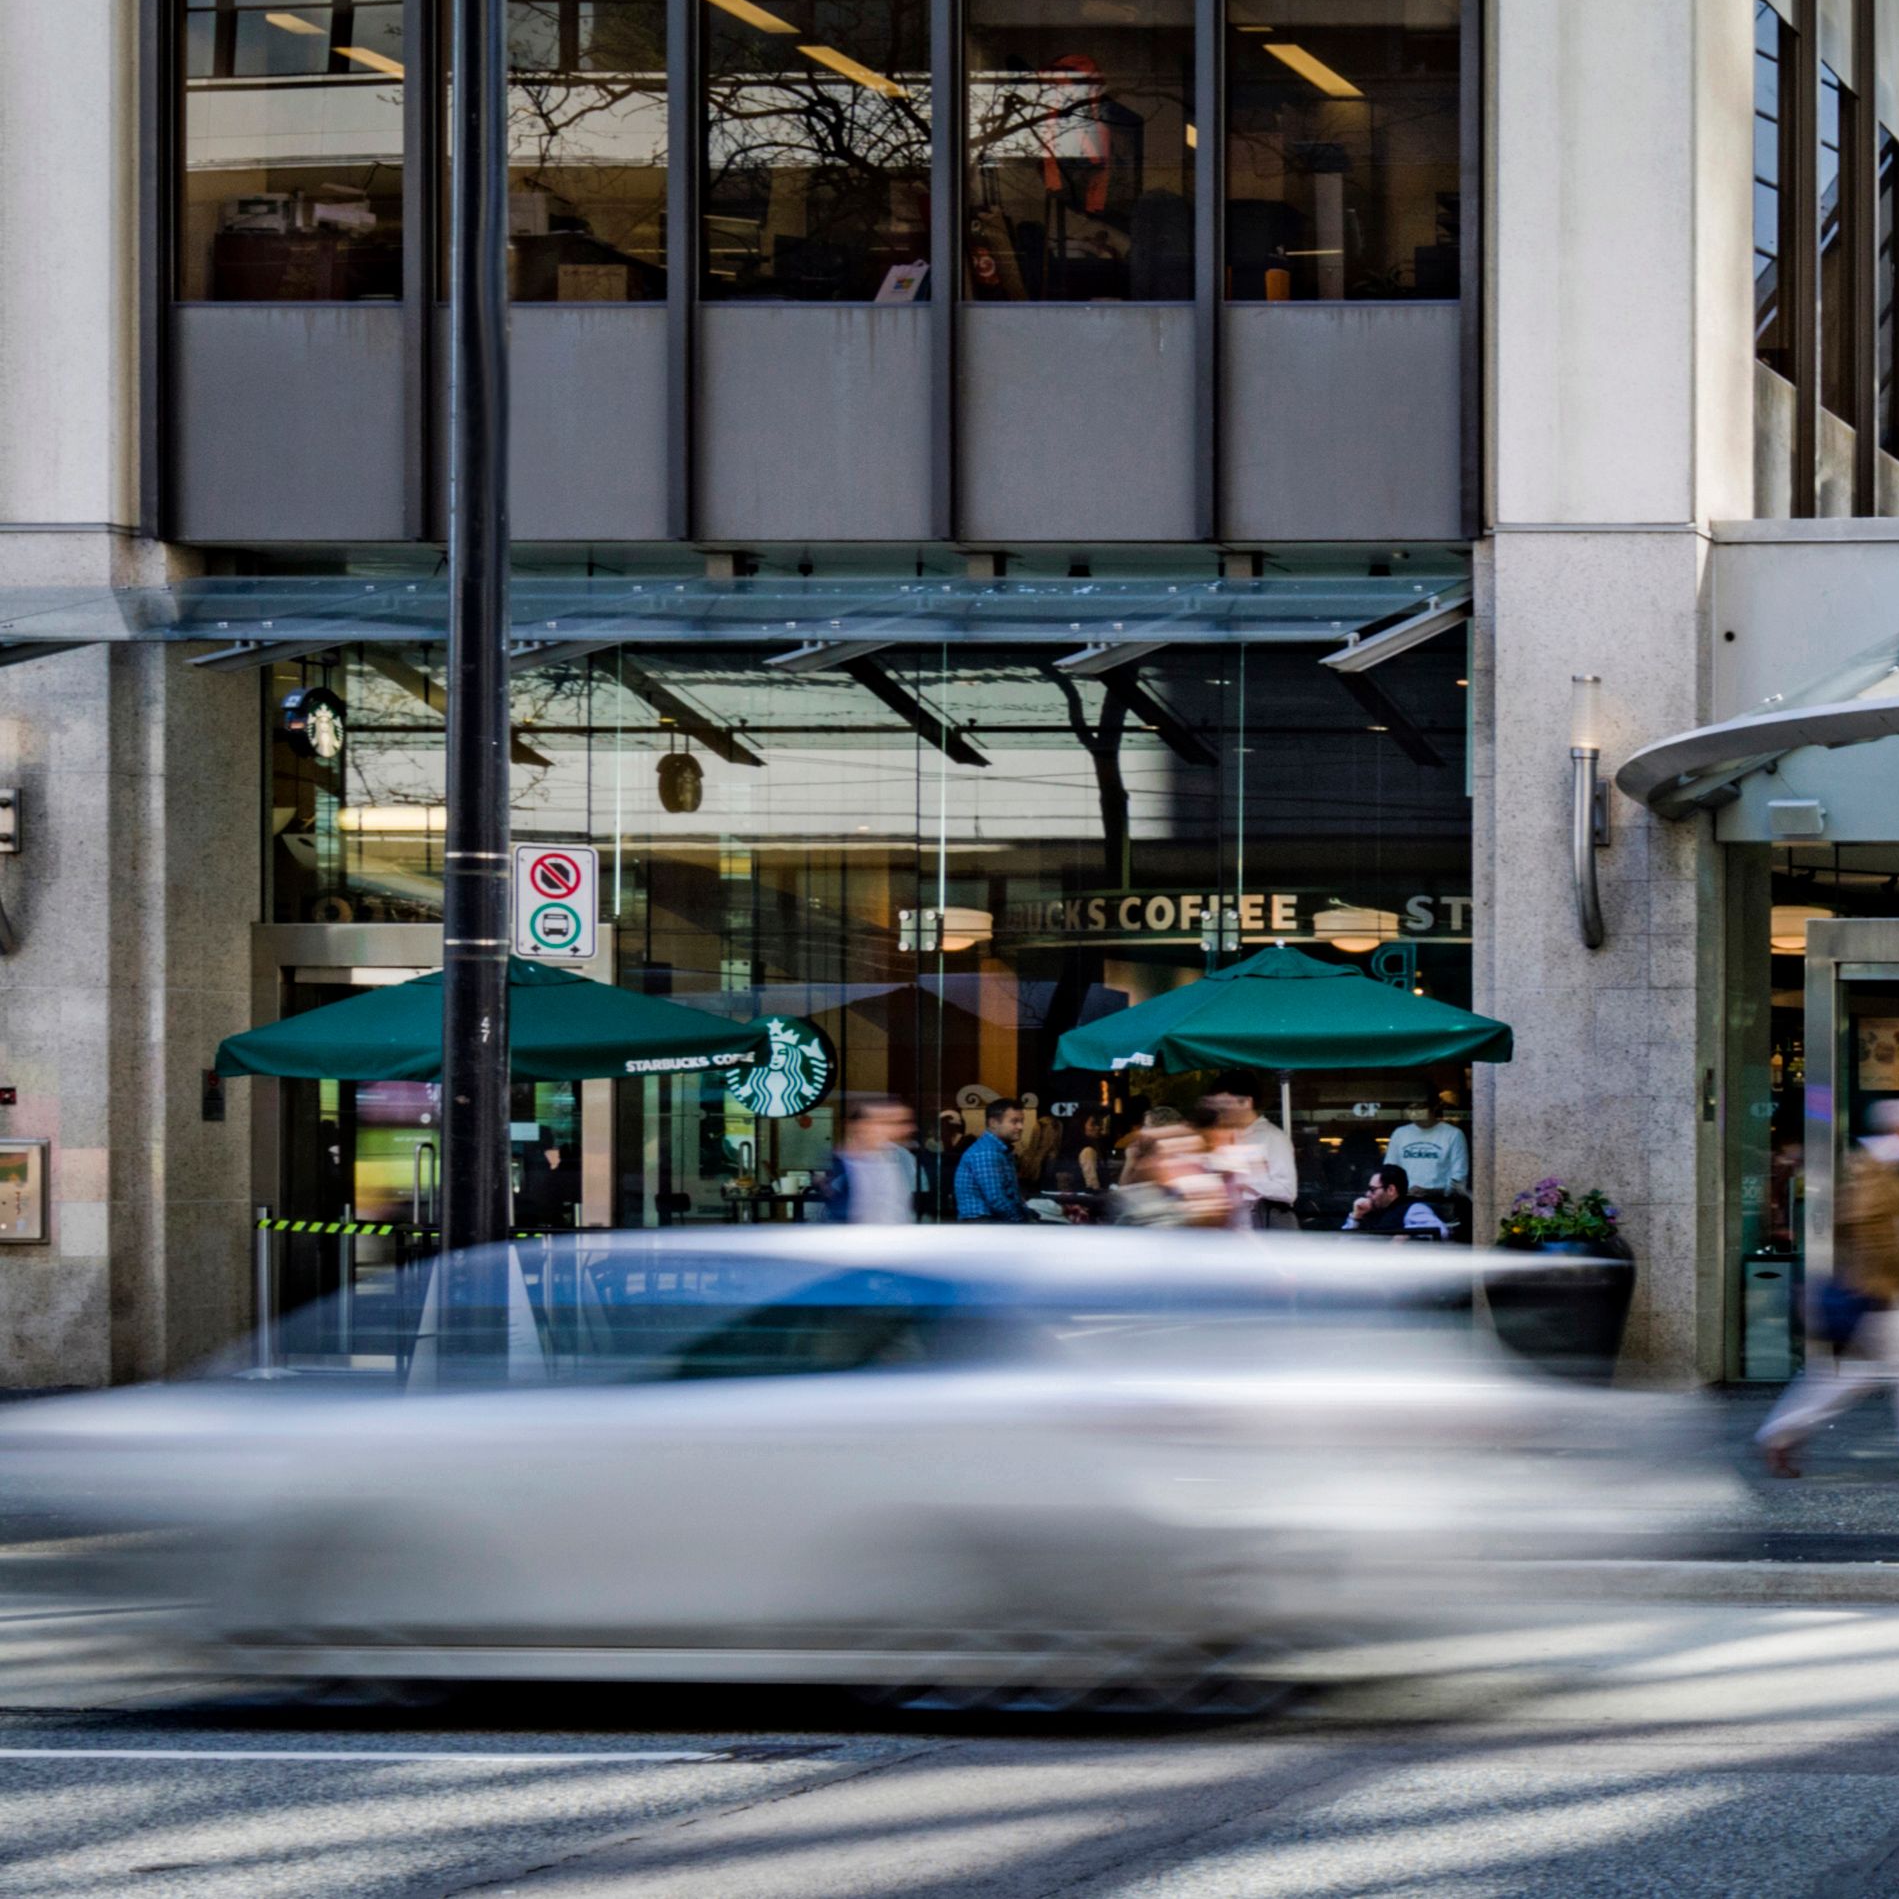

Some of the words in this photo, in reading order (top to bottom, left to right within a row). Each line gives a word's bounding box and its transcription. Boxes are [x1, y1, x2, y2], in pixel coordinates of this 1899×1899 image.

[625, 1054, 710, 1073] STARBUCKS
[1051, 1102, 1079, 1117] CF
[1352, 1103, 1381, 1117] CF
